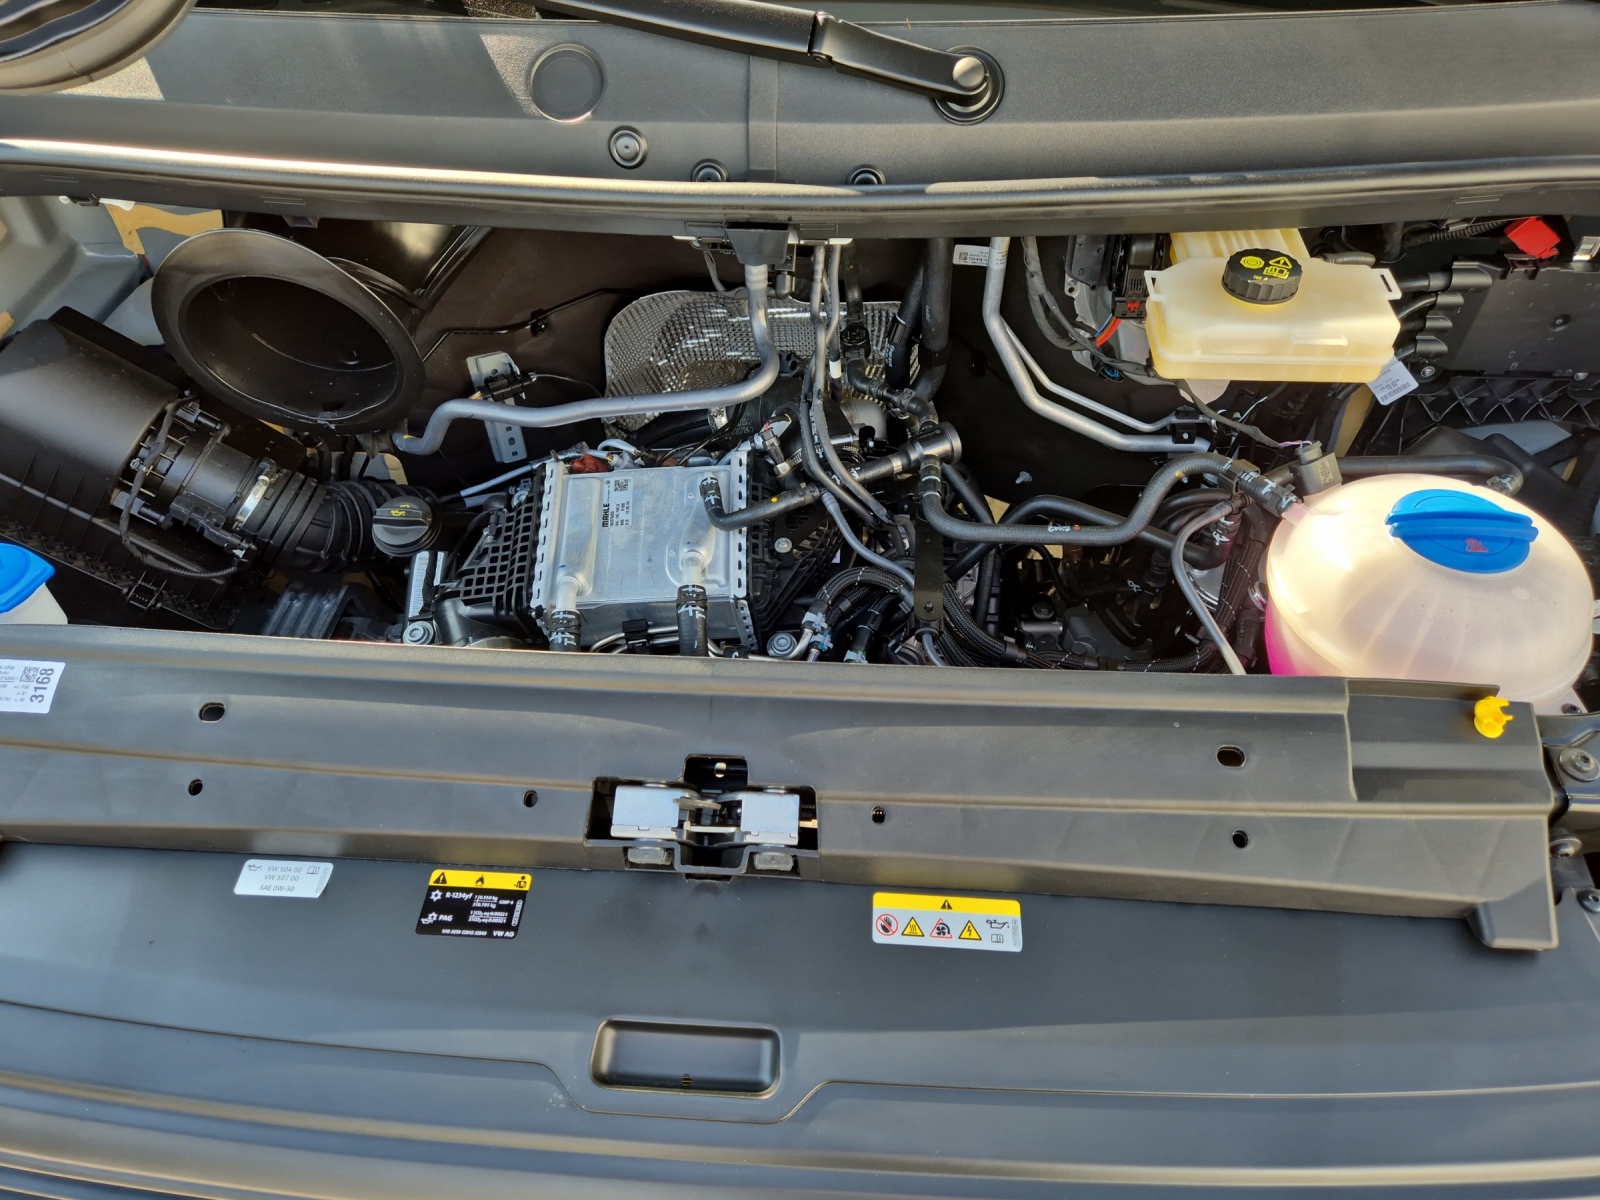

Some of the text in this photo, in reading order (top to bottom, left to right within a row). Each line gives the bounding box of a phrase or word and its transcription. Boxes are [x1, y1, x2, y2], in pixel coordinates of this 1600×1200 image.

[602, 503, 610, 527] MAHLE
[30, 668, 54, 703] 3168
[445, 892, 473, 901] R-1234yf
